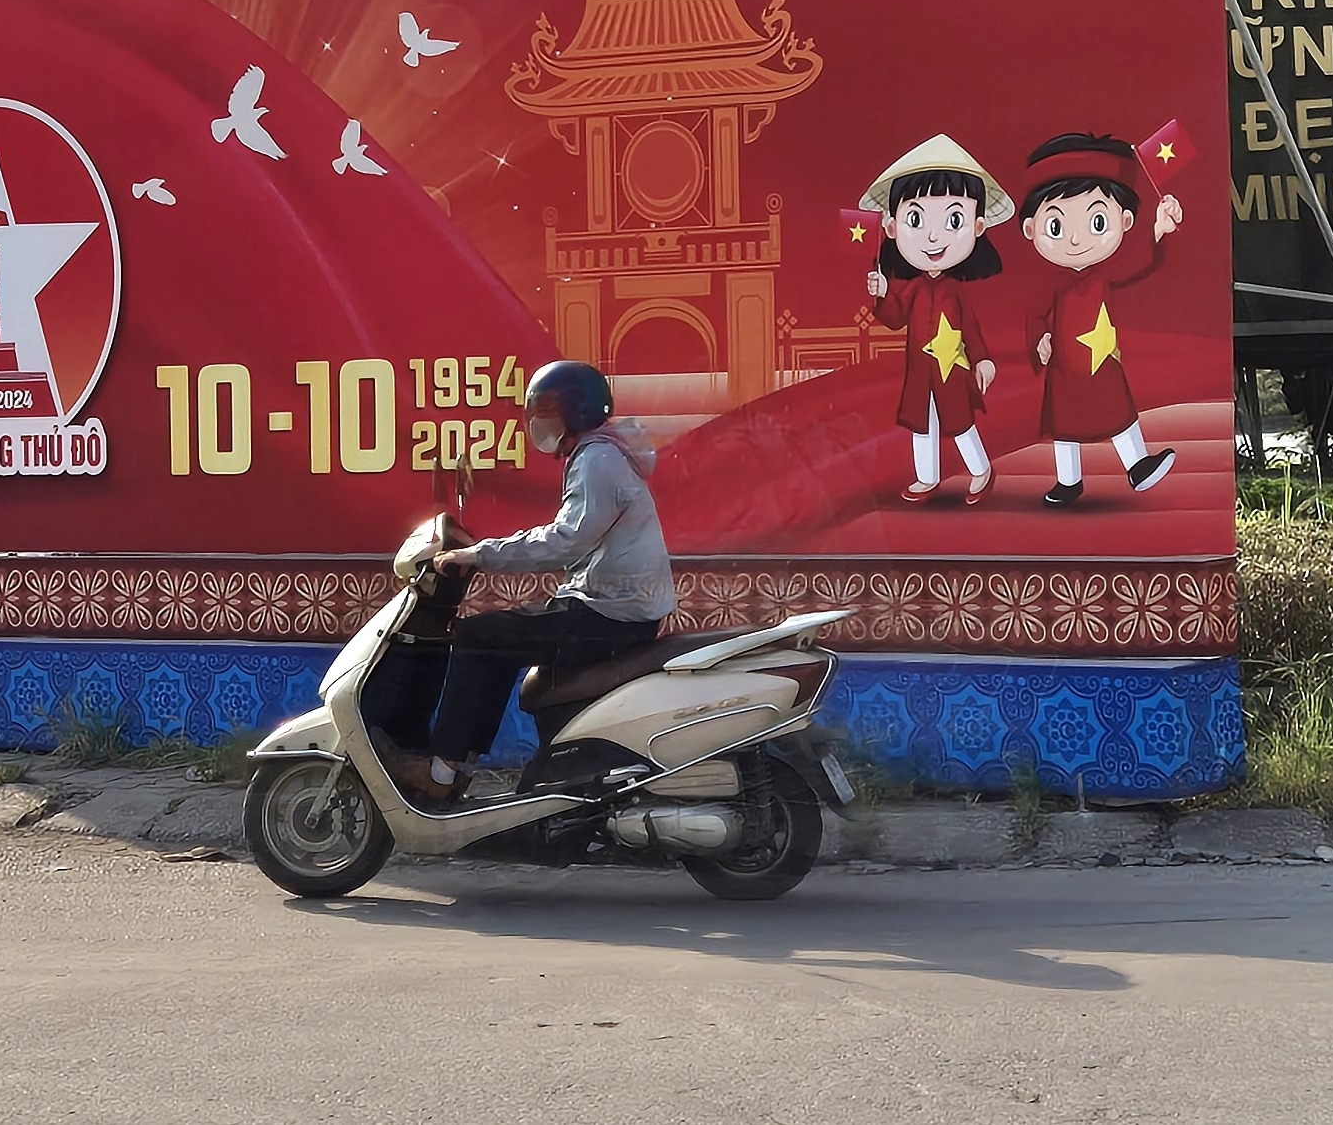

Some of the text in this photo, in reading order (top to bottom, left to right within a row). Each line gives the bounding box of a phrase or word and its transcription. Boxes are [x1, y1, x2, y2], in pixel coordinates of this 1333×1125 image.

[409, 355, 525, 408] 1954
[21, 425, 63, 467] THỦ
[70, 427, 102, 467] ĐÔ
[411, 419, 526, 471] 2024
